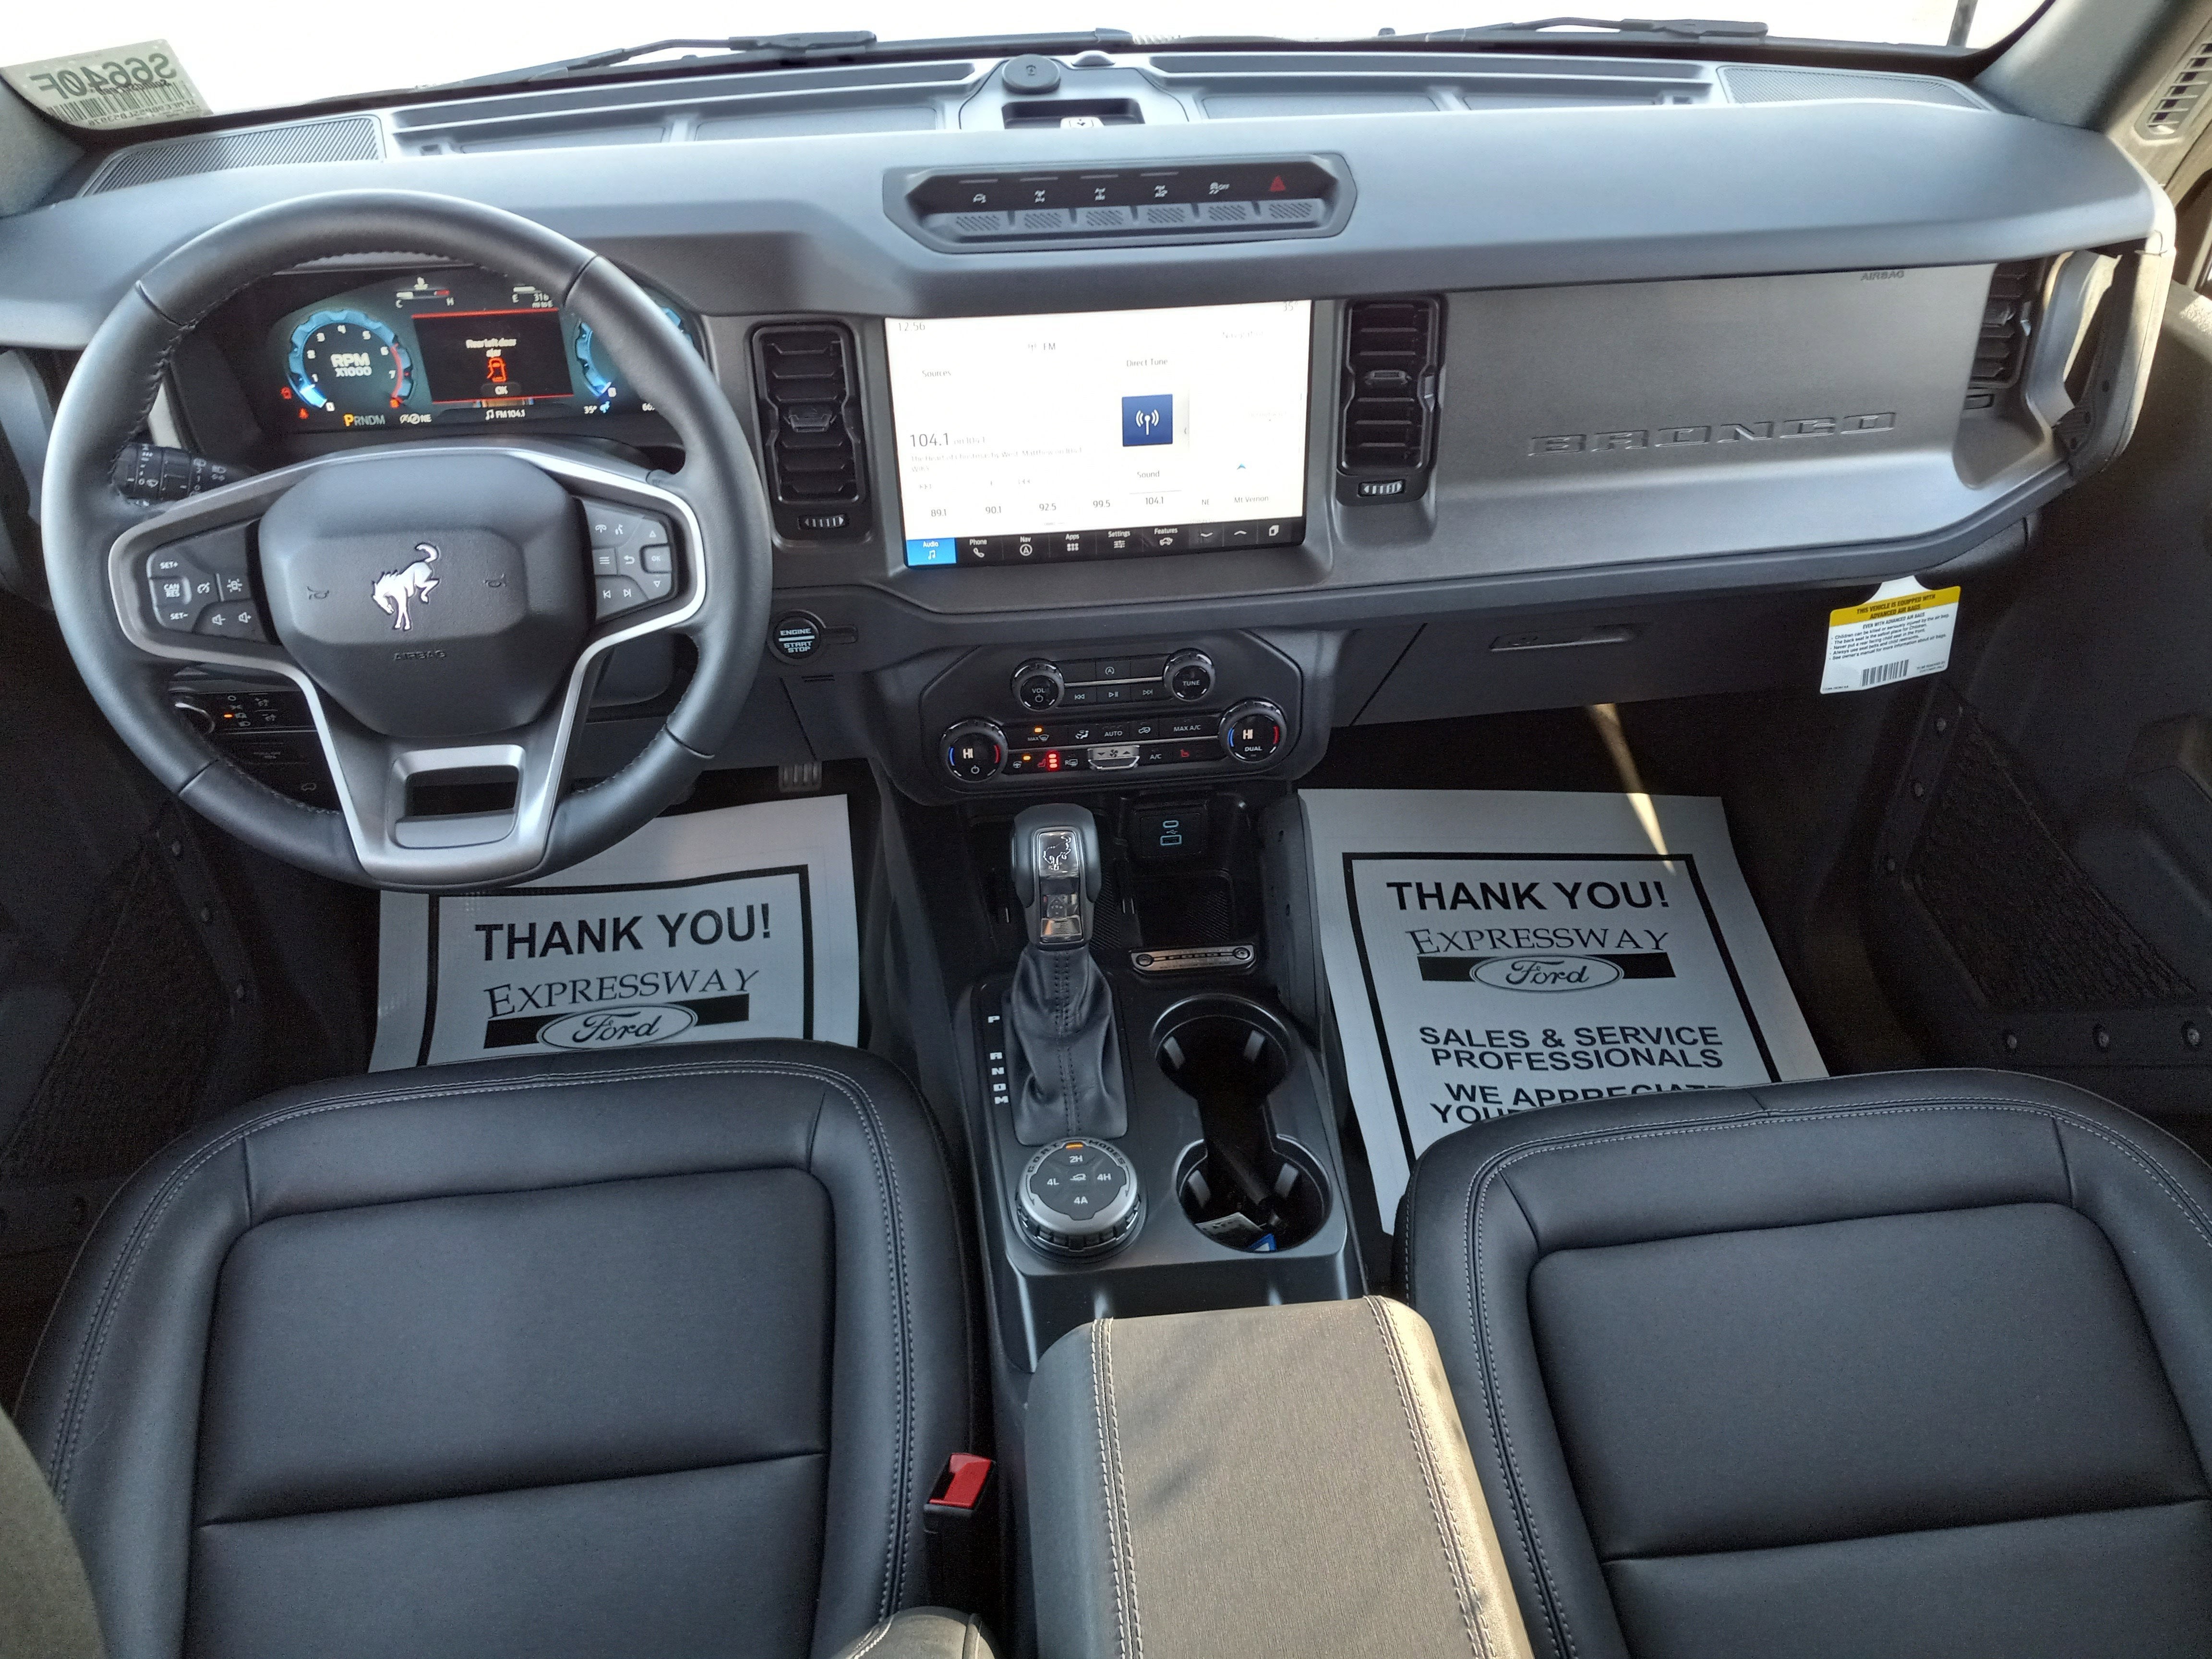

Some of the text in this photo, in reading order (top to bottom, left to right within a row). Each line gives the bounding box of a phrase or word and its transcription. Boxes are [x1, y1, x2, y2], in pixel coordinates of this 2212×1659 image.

[1861, 270, 1905, 281] AIRBAG
[337, 325, 346, 334] 4
[316, 332, 325, 342] 3
[362, 330, 371, 340] 5
[307, 349, 316, 359] 2
[380, 346, 389, 356] 6
[330, 352, 371, 368] RPM
[1126, 359, 1148, 367] Direct
[335, 366, 372, 377] X1000
[388, 370, 396, 379] 7
[312, 373, 318, 382] 1
[494, 385, 508, 395] OK
[325, 402, 335, 411] 0
[1528, 412, 1896, 456] BRONCO
[910, 433, 949, 447] 104.1
[1093, 500, 1110, 508] 99.5
[1145, 496, 1164, 505] 104.1
[985, 506, 1002, 514] 90.1
[1039, 503, 1057, 511] 92.5
[931, 509, 947, 517] 89.1
[1108, 529, 1131, 538] Settings
[1154, 527, 1178, 535] Features
[1065, 533, 1080, 541] Apps
[159, 561, 178, 569] SET+
[1870, 603, 1890, 612] VEHICLE
[1897, 597, 1922, 606] EQUIPPED
[1869, 610, 1896, 619] ADVANCED
[1907, 604, 1921, 612] BAGS
[1242, 729, 1253, 740] HI
[962, 747, 974, 759] HI
[1386, 881, 1670, 911] THANK YOU!
[475, 902, 771, 961] THANK YOU!
[1405, 927, 1669, 955] EXPRESSWAY
[1505, 960, 1590, 985] Ford
[483, 968, 759, 1019] EXPRESSWAY
[572, 1011, 662, 1043] Ford
[1419, 1025, 1723, 1048] SALES & SERVICE
[989, 1052, 1003, 1060] R
[1431, 1047, 1723, 1071] PROFESSIONALS
[991, 1067, 1005, 1075] N
[993, 1083, 1006, 1092] D
[1444, 1082, 1507, 1106] WE
[994, 1095, 1009, 1104] M
[1088, 1139, 1126, 1165] MODES
[1069, 1155, 1083, 1163] 2H
[1073, 1196, 1088, 1204] 4A
